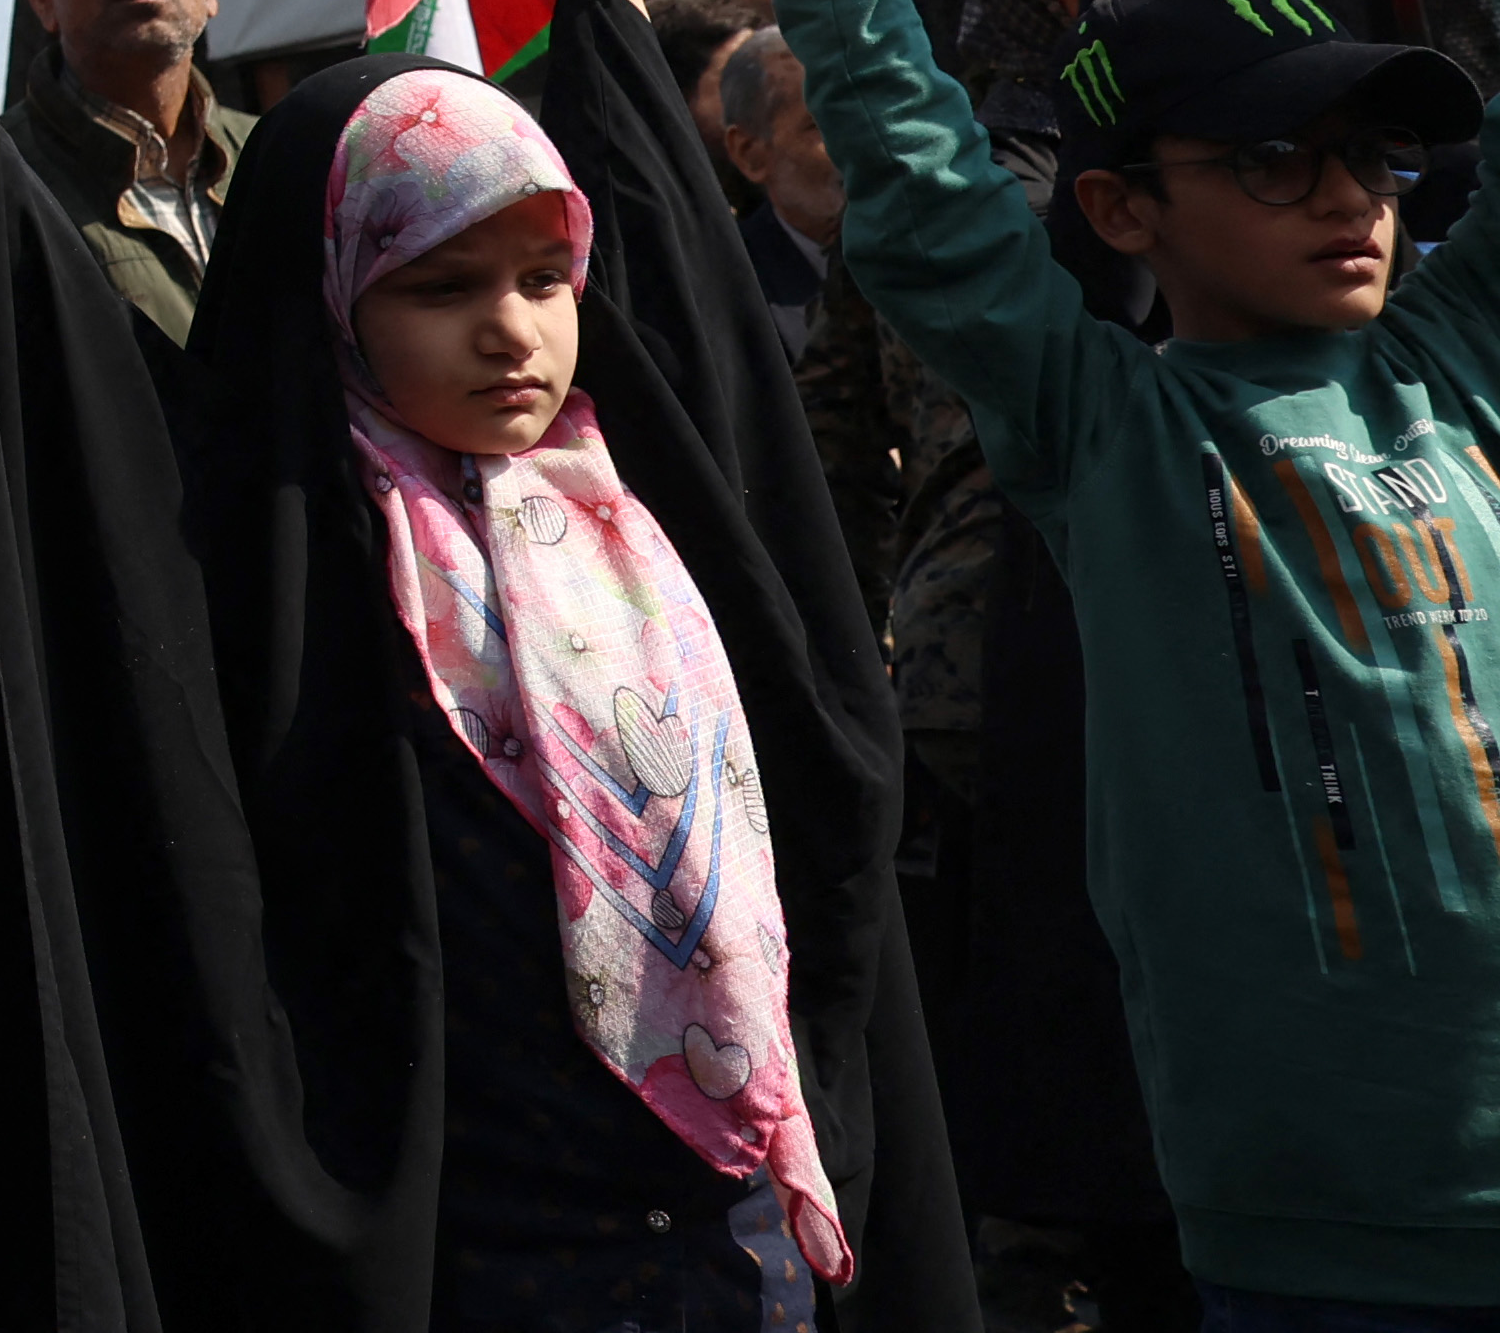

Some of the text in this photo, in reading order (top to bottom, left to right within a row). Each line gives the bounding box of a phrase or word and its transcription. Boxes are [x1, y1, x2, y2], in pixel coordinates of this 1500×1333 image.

[1259, 434, 1350, 461] Dreaming
[1324, 458, 1448, 515] STAND
[1353, 517, 1474, 608] OUT
[1383, 611, 1427, 630] TREND
[1320, 763, 1342, 805] THINK
